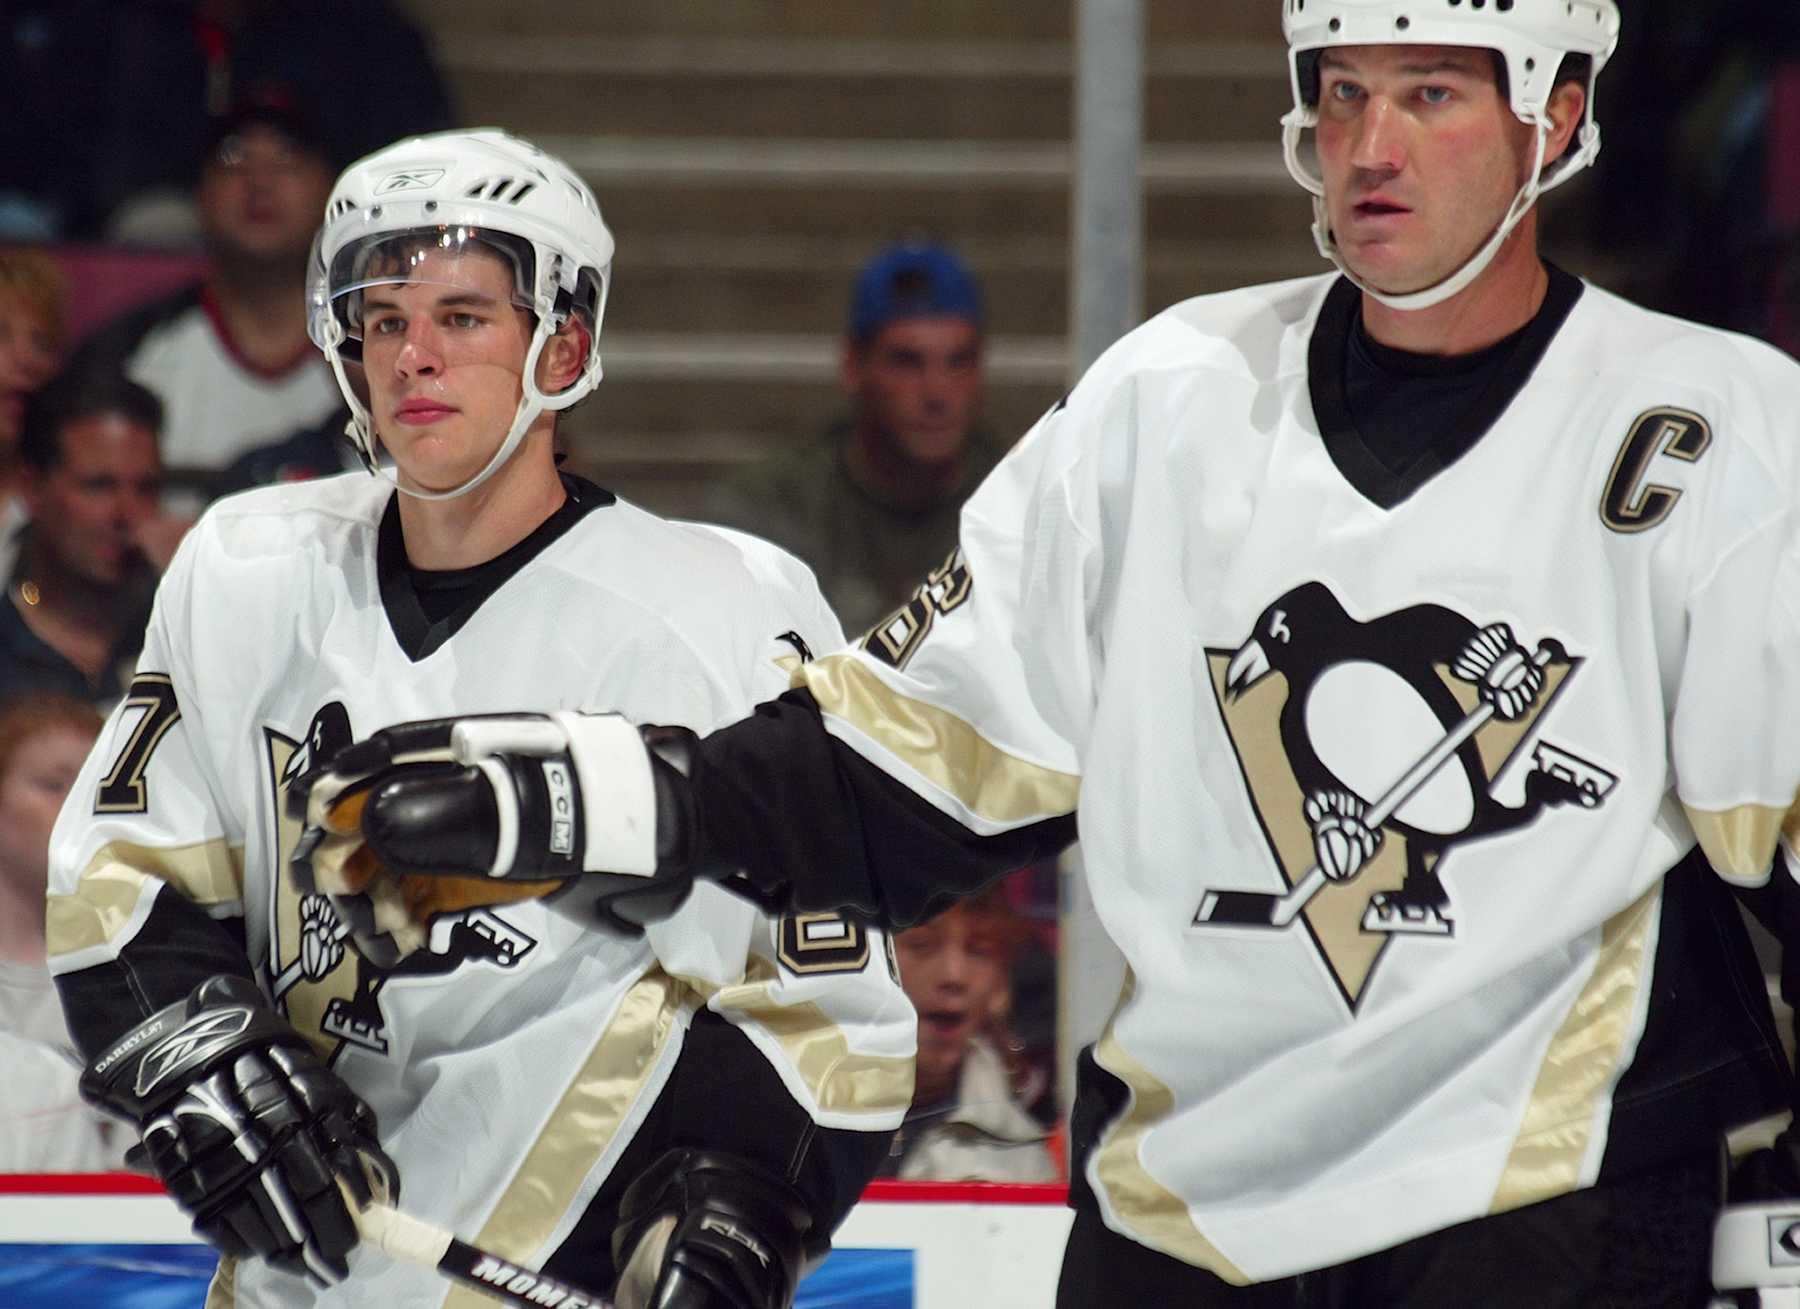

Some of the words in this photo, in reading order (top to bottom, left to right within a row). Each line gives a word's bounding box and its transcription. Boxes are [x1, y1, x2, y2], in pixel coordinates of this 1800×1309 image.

[1599, 405, 1713, 533] C
[93, 672, 182, 815] 7
[550, 769, 571, 852] CCM
[471, 1254, 608, 1309] MOME
